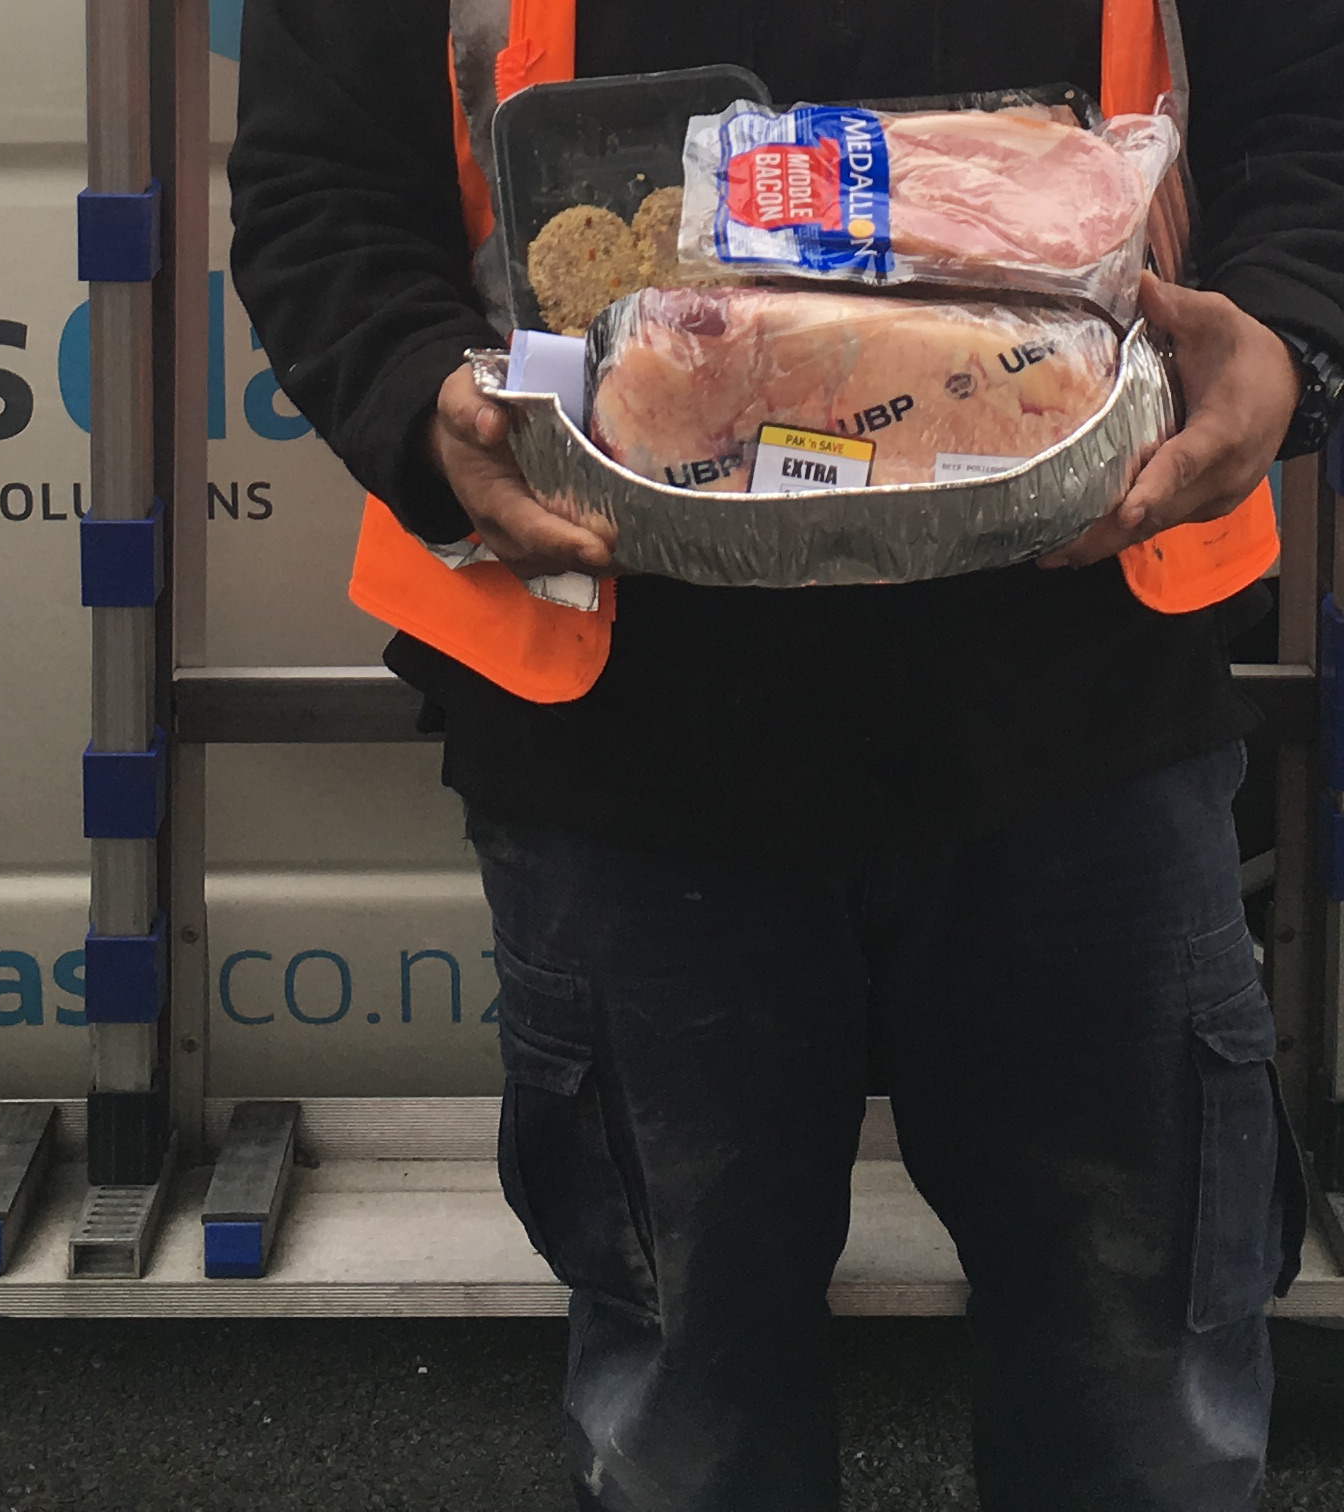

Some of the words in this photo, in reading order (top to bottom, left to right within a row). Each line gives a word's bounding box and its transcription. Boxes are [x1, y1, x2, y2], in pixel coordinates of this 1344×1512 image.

[755, 153, 784, 222] BACON
[787, 153, 813, 219] MIDDLE
[840, 115, 878, 257] MEDALLION
[837, 395, 914, 436] UBP
[785, 434, 806, 446] PAK
[819, 440, 845, 454] SAVE
[664, 453, 742, 488] UBP
[782, 456, 838, 485] EXTRA
